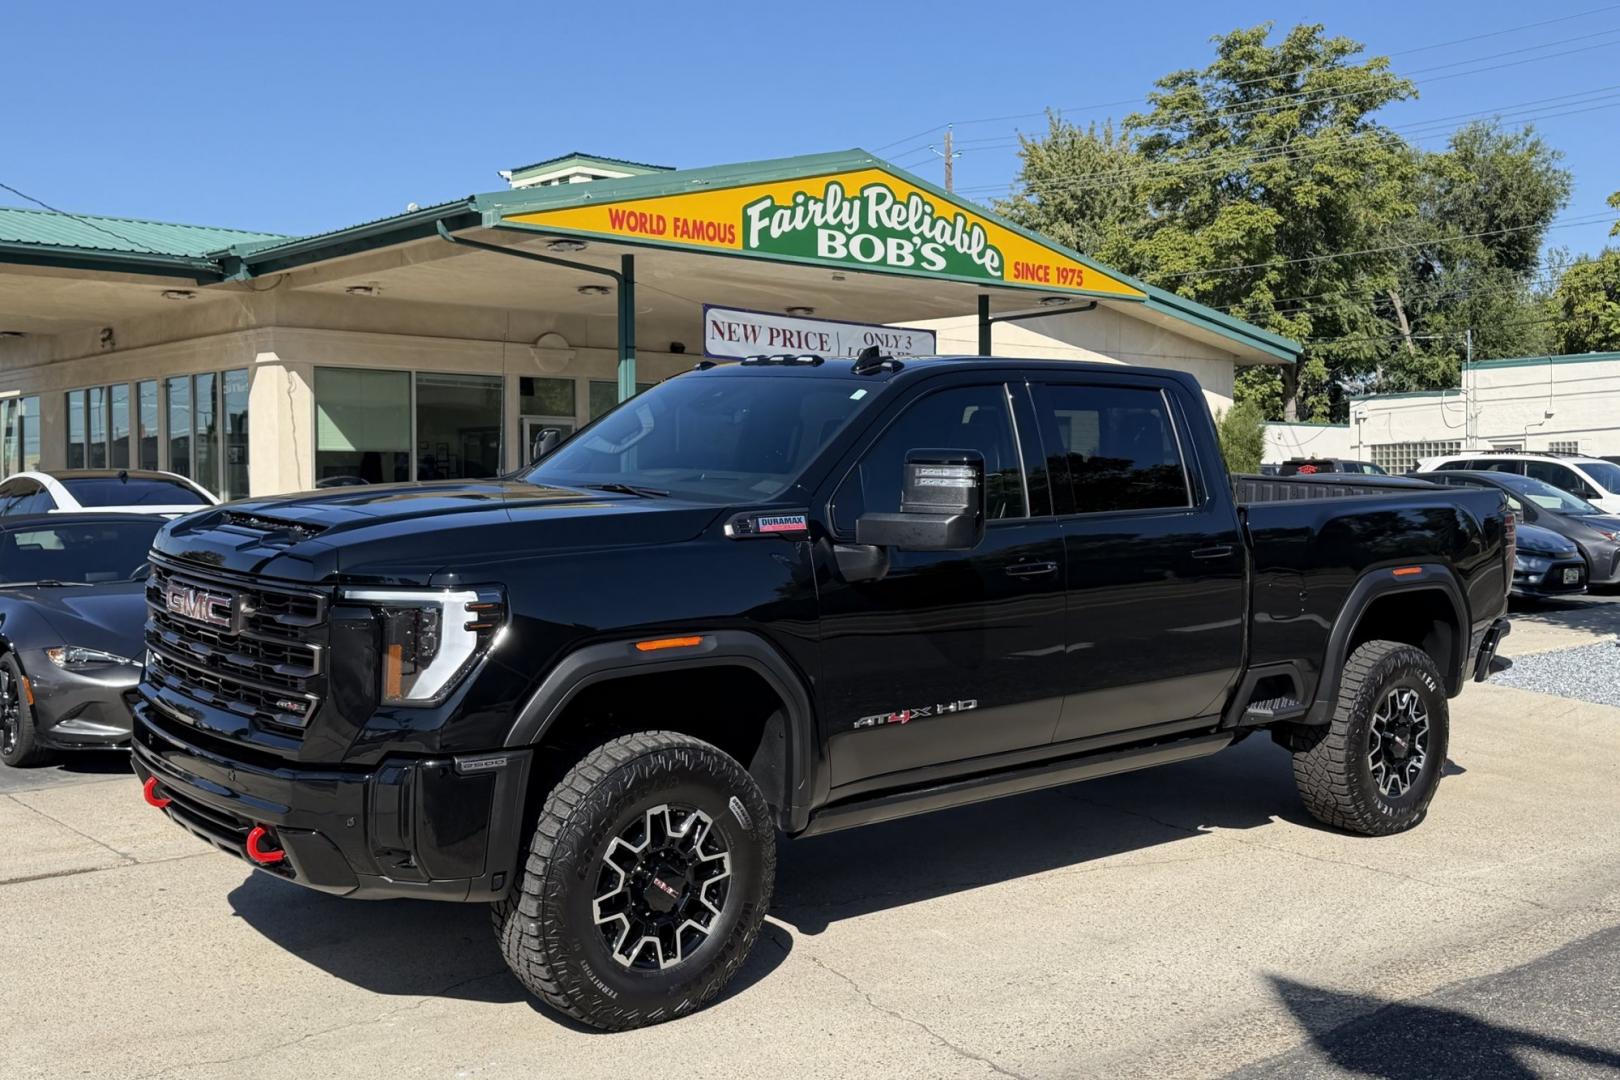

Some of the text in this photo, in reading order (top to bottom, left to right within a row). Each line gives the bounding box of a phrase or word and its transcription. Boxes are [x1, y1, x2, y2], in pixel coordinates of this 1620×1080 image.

[608, 207, 736, 244] WORLD FAMOUS
[747, 183, 1001, 276] Fairly Reliable
[817, 228, 947, 271] BOB'S
[1013, 261, 1084, 287] SINCE 1975
[710, 320, 831, 352] NEW PRICE
[863, 332, 912, 350] ONLY 3
[761, 516, 803, 526] DURAMAX
[166, 585, 232, 627] GMC
[853, 699, 978, 729] AT4X HD
[653, 877, 680, 899] GMC
